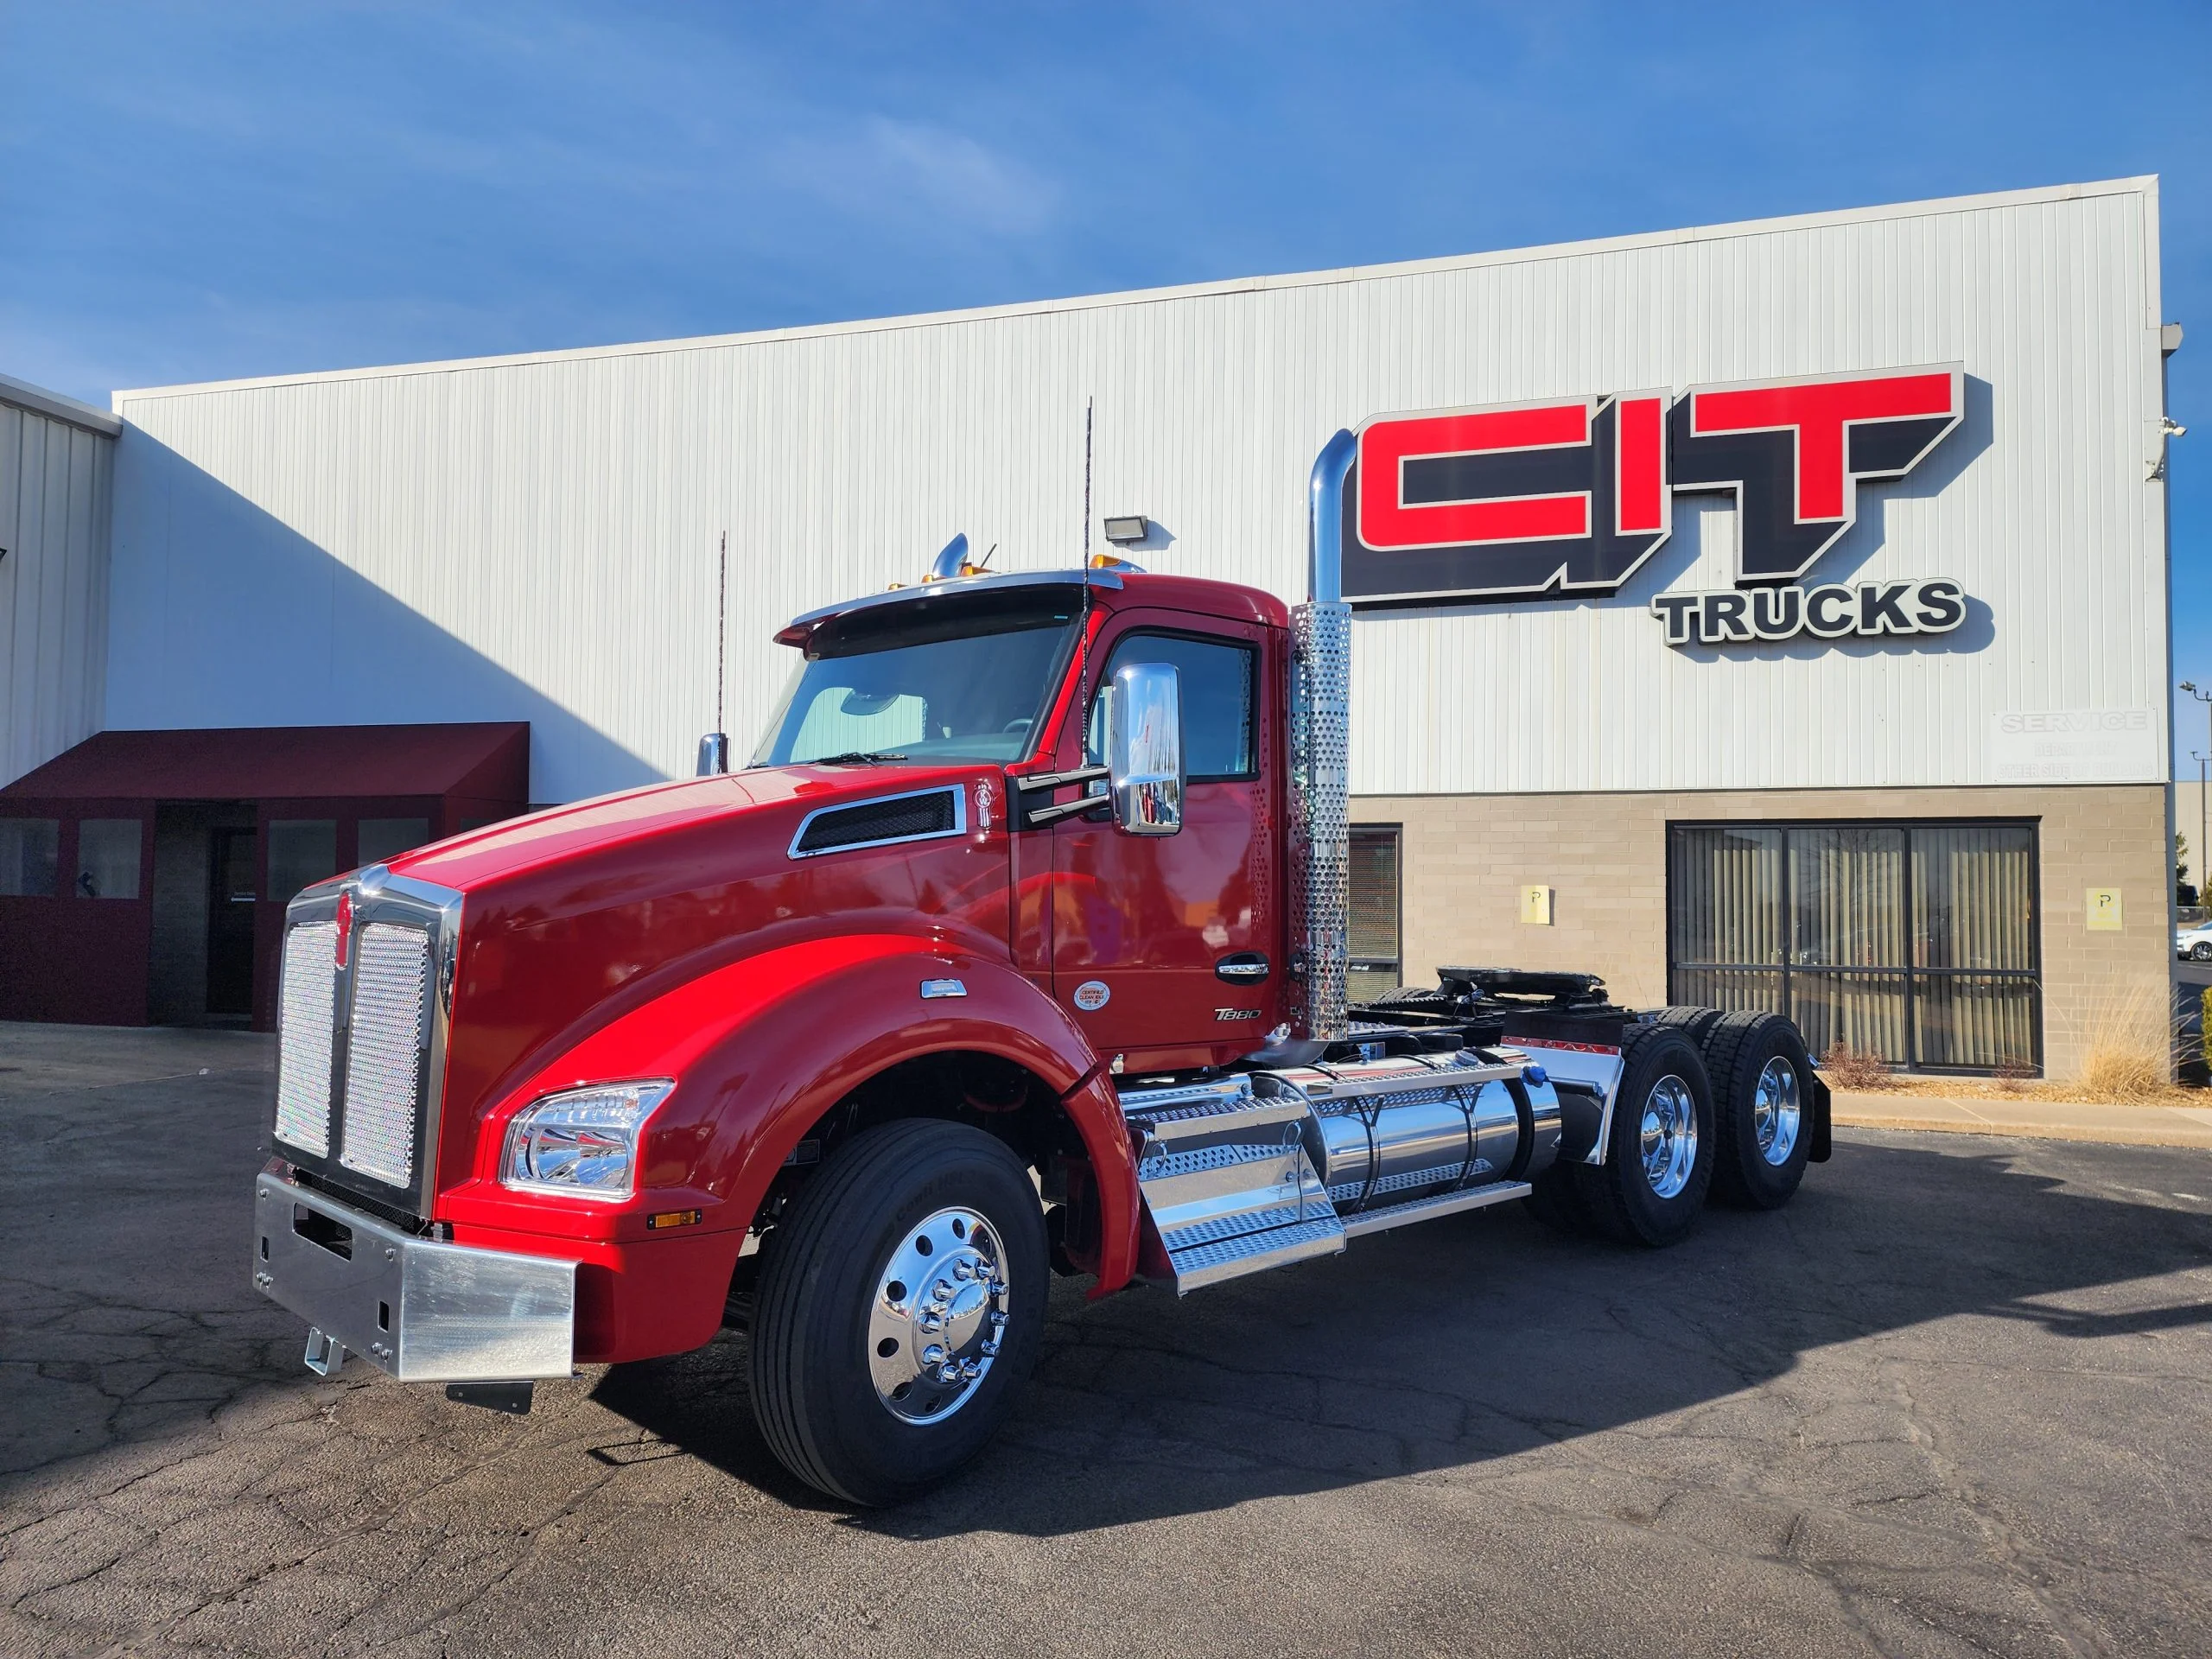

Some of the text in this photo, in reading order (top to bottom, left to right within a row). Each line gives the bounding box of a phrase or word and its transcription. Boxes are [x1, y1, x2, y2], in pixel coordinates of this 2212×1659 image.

[1350, 363, 1961, 560] CIT
[1654, 582, 1962, 639] TRUCKS
[2002, 711, 2147, 733] SERVICE
[1214, 1007, 1262, 1020] T880
